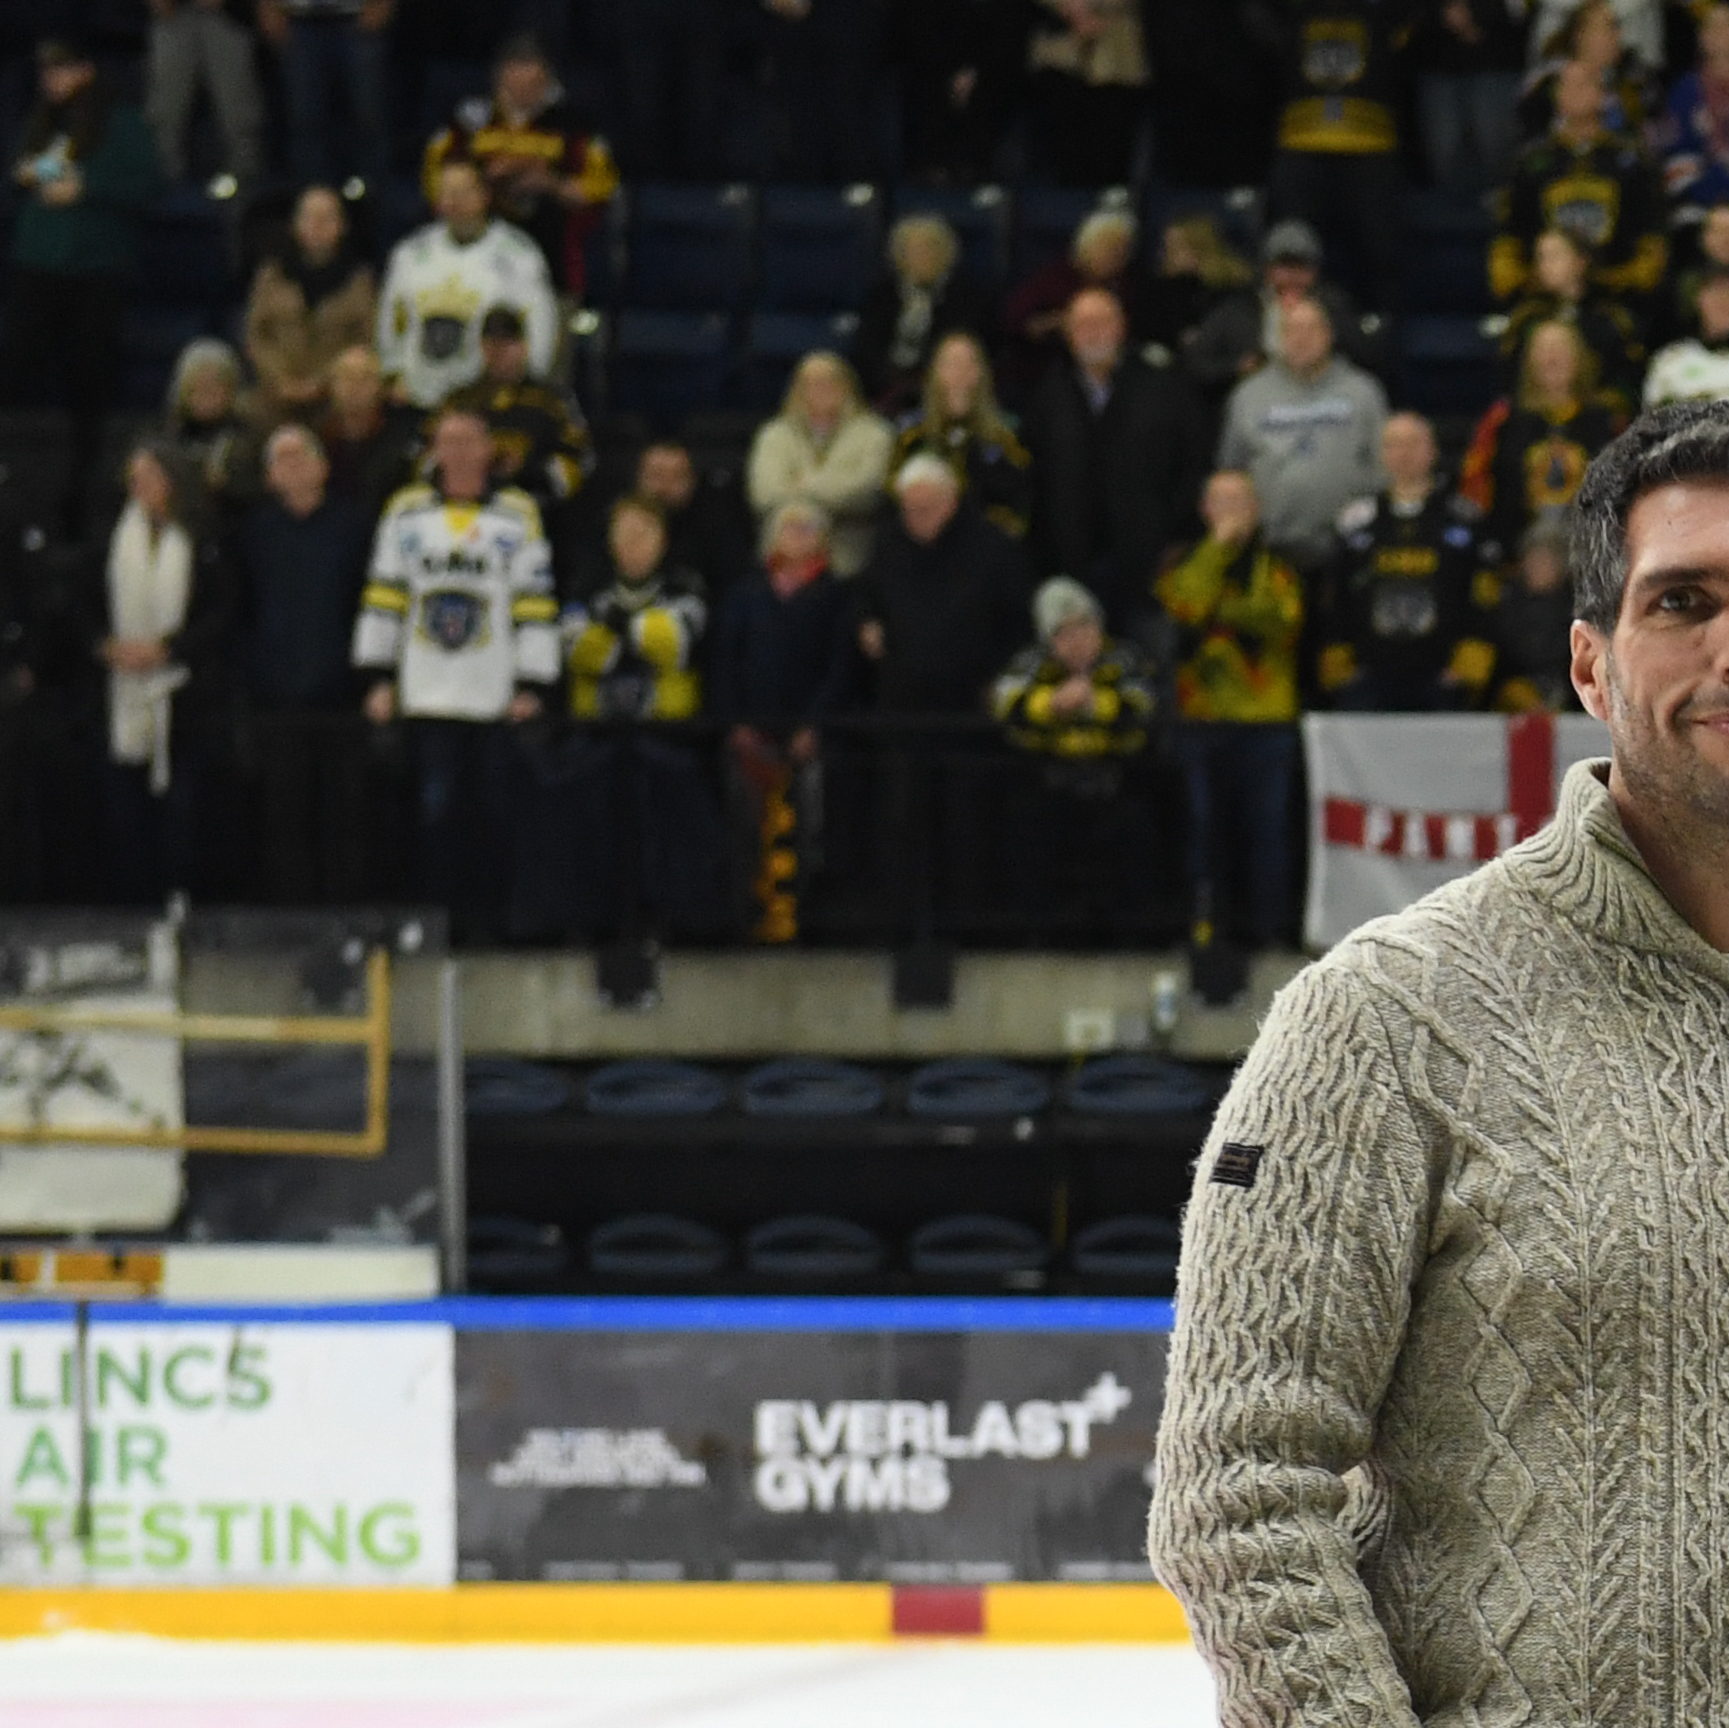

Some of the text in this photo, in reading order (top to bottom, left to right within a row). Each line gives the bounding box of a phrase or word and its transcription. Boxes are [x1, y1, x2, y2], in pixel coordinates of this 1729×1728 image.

[10, 1345, 274, 1410] LINCS
[14, 1424, 170, 1488] AIR
[754, 1398, 1093, 1461] EVERLAST
[754, 1455, 952, 1514] GYMS
[13, 1502, 423, 1568] TESTING
